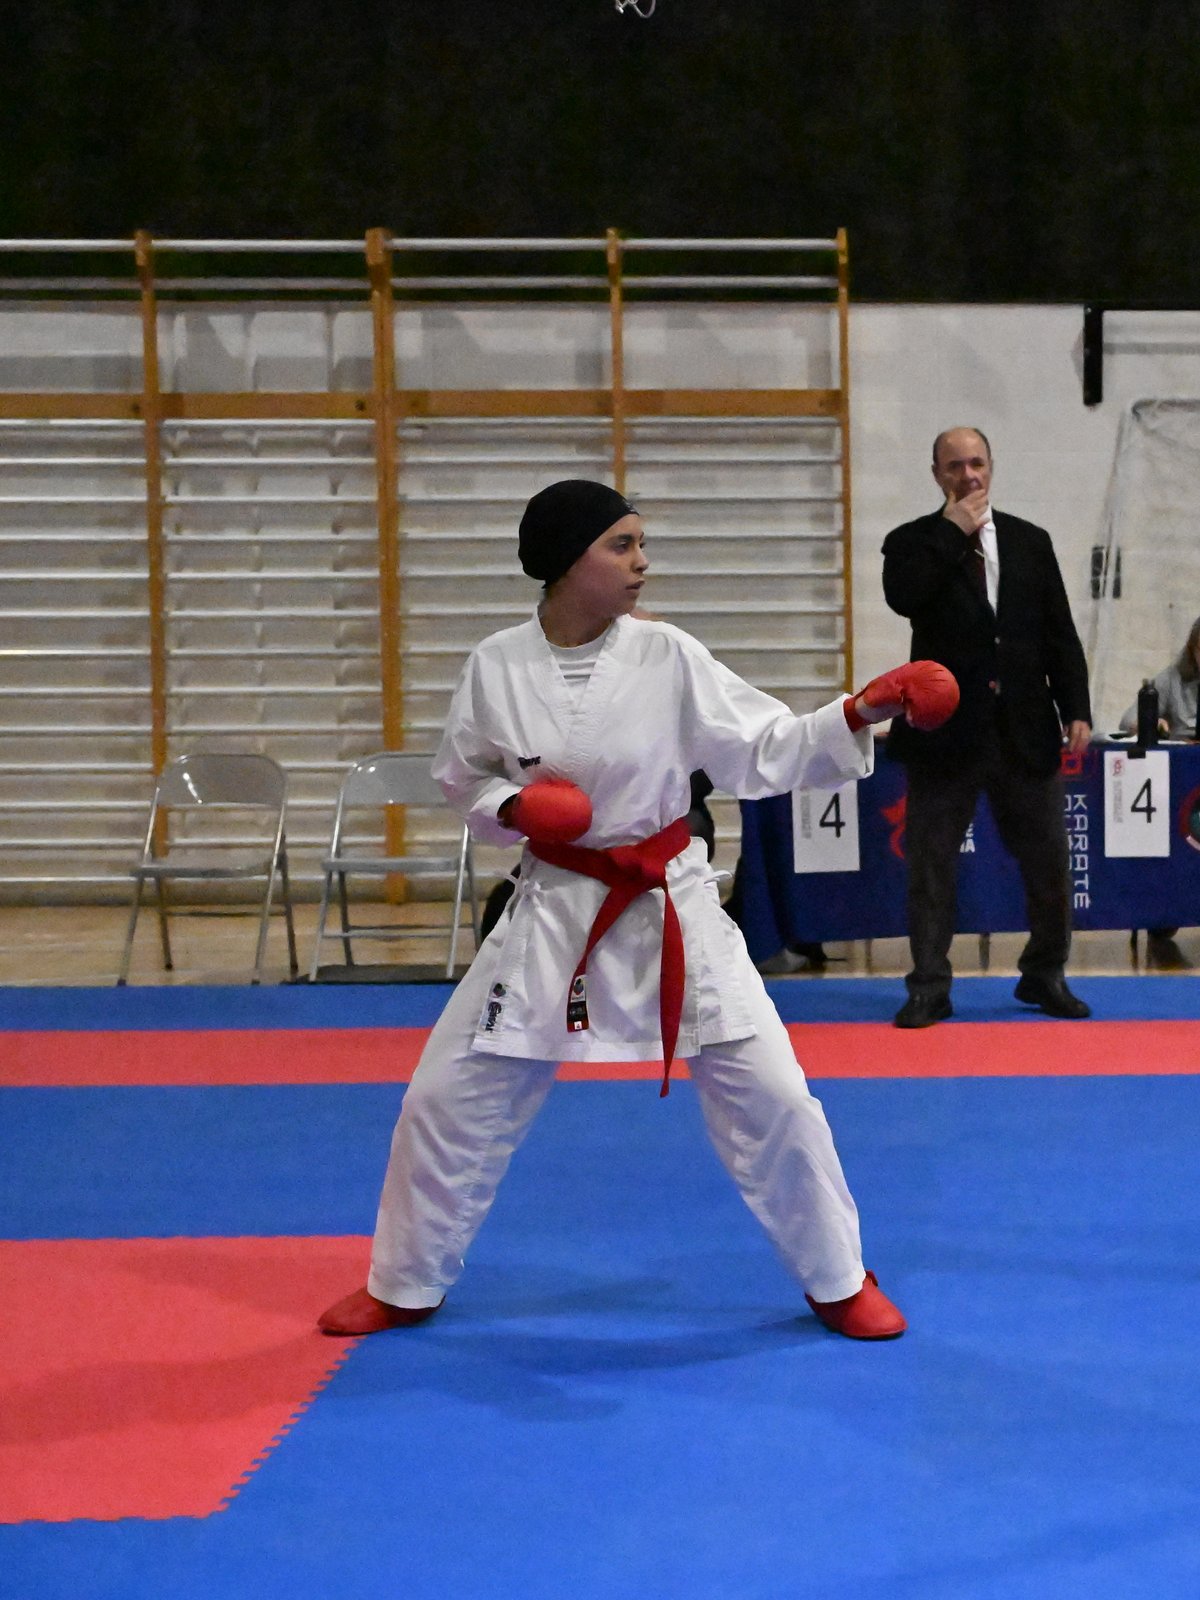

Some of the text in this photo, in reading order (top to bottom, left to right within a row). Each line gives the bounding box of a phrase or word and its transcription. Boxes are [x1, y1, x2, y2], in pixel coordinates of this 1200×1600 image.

[819, 792, 846, 838] 4
[1131, 778, 1157, 823] 4
[1073, 794, 1091, 910] KARATE
